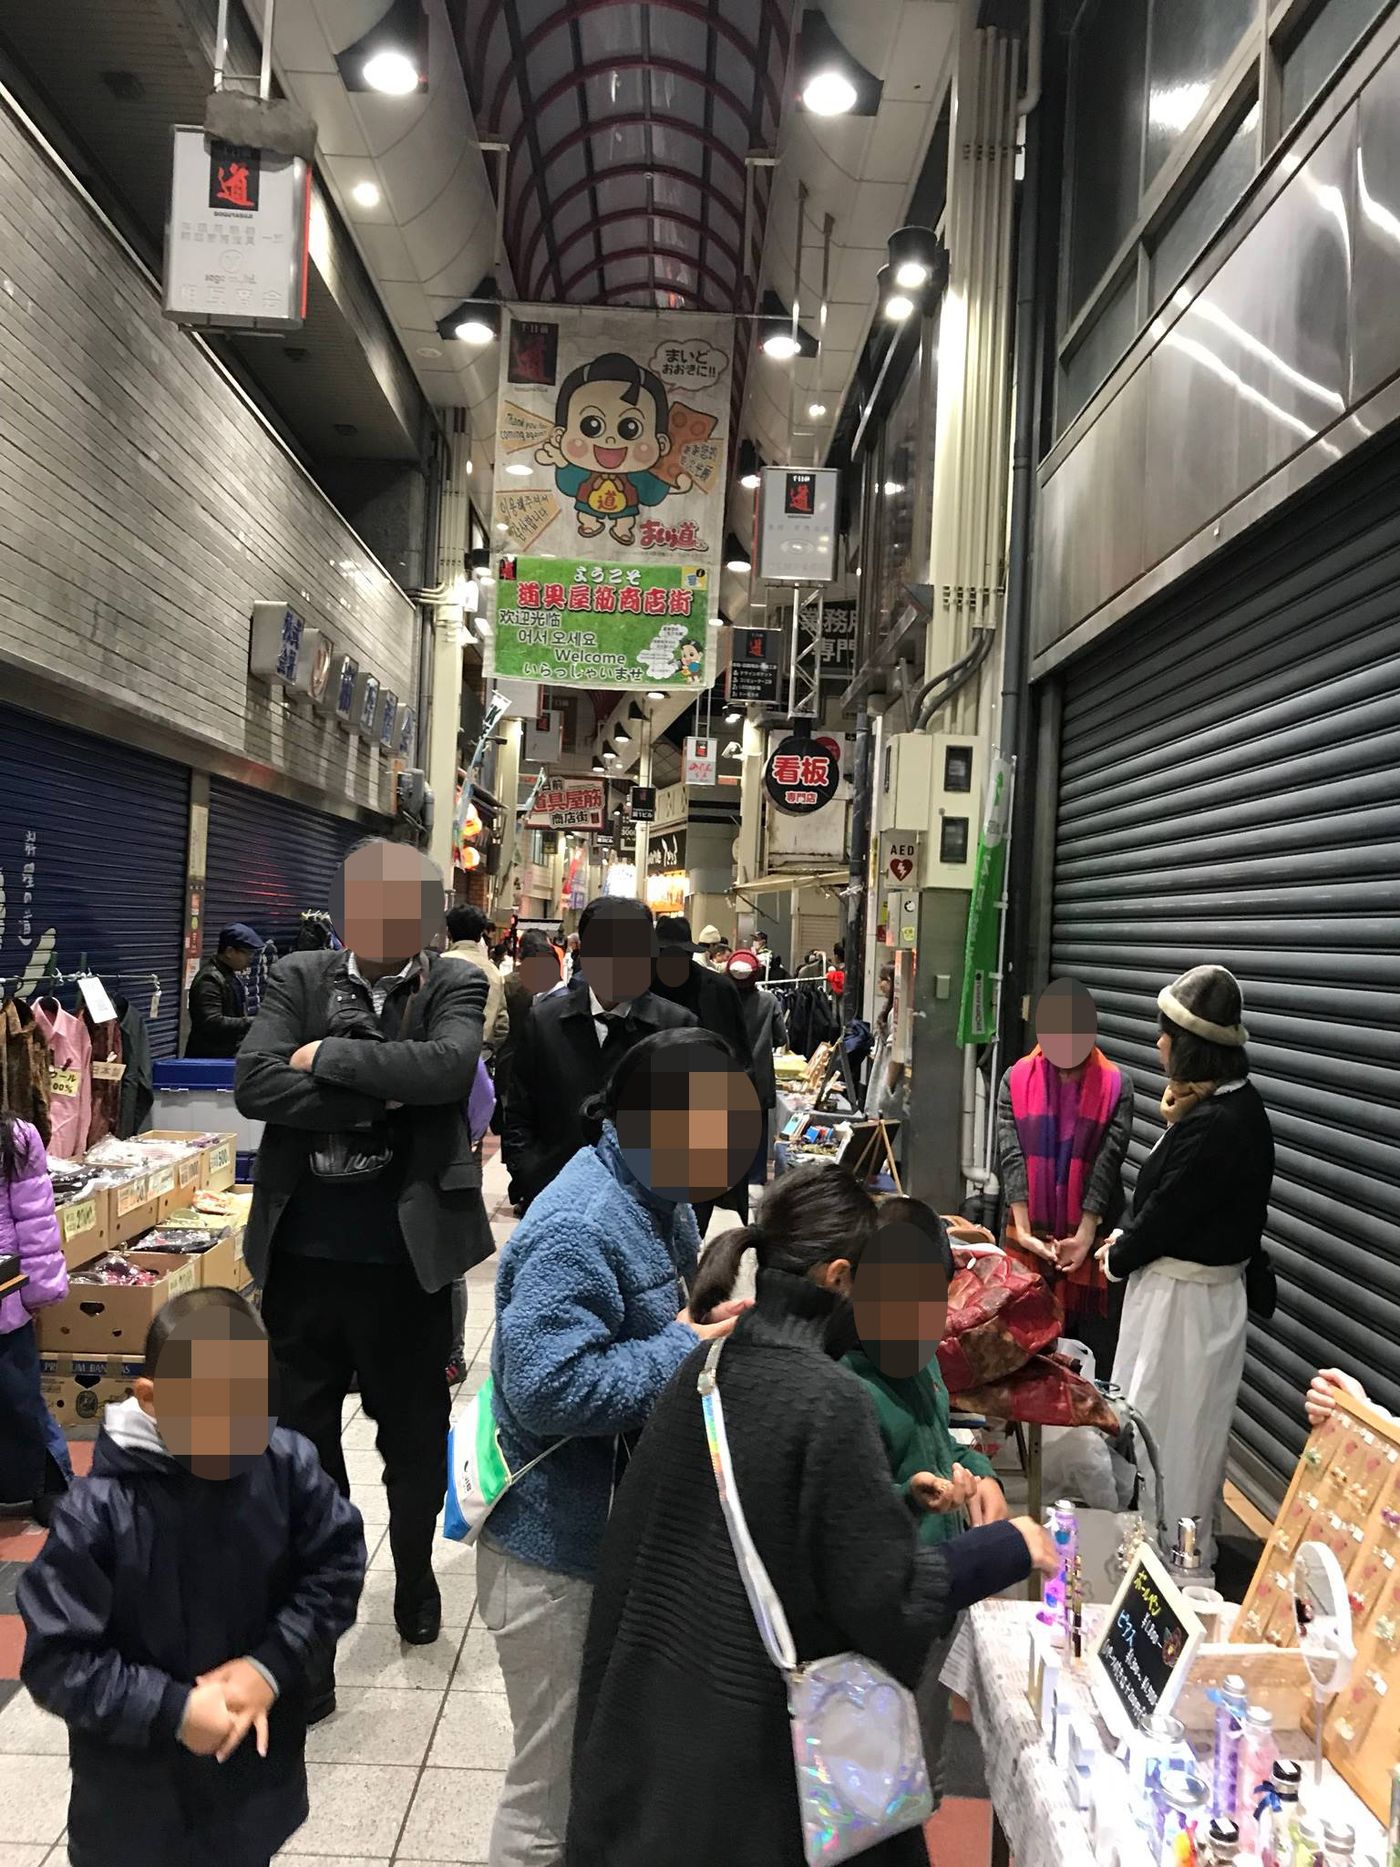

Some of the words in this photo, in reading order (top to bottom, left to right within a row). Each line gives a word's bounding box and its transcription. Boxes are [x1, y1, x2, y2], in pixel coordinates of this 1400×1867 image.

[216, 162, 256, 208] 道
[665, 348, 710, 365] まいど
[597, 489, 618, 510] 道
[574, 566, 643, 586] ようこそ
[516, 580, 694, 616] 道具屋筋商店街
[499, 609, 561, 627] 欢迎光临
[518, 629, 548, 644] 어서
[551, 631, 597, 647] 오세요
[555, 649, 626, 665] Welcome
[523, 663, 644, 681] いらっしゃいませ
[772, 755, 830, 787] 看板
[551, 811, 588, 825] 商店街
[890, 844, 915, 856] AED
[53, 1082, 74, 1093] 00%
[1133, 1570, 1162, 1617] ボールペン
[1117, 1609, 1137, 1648] ピアス
